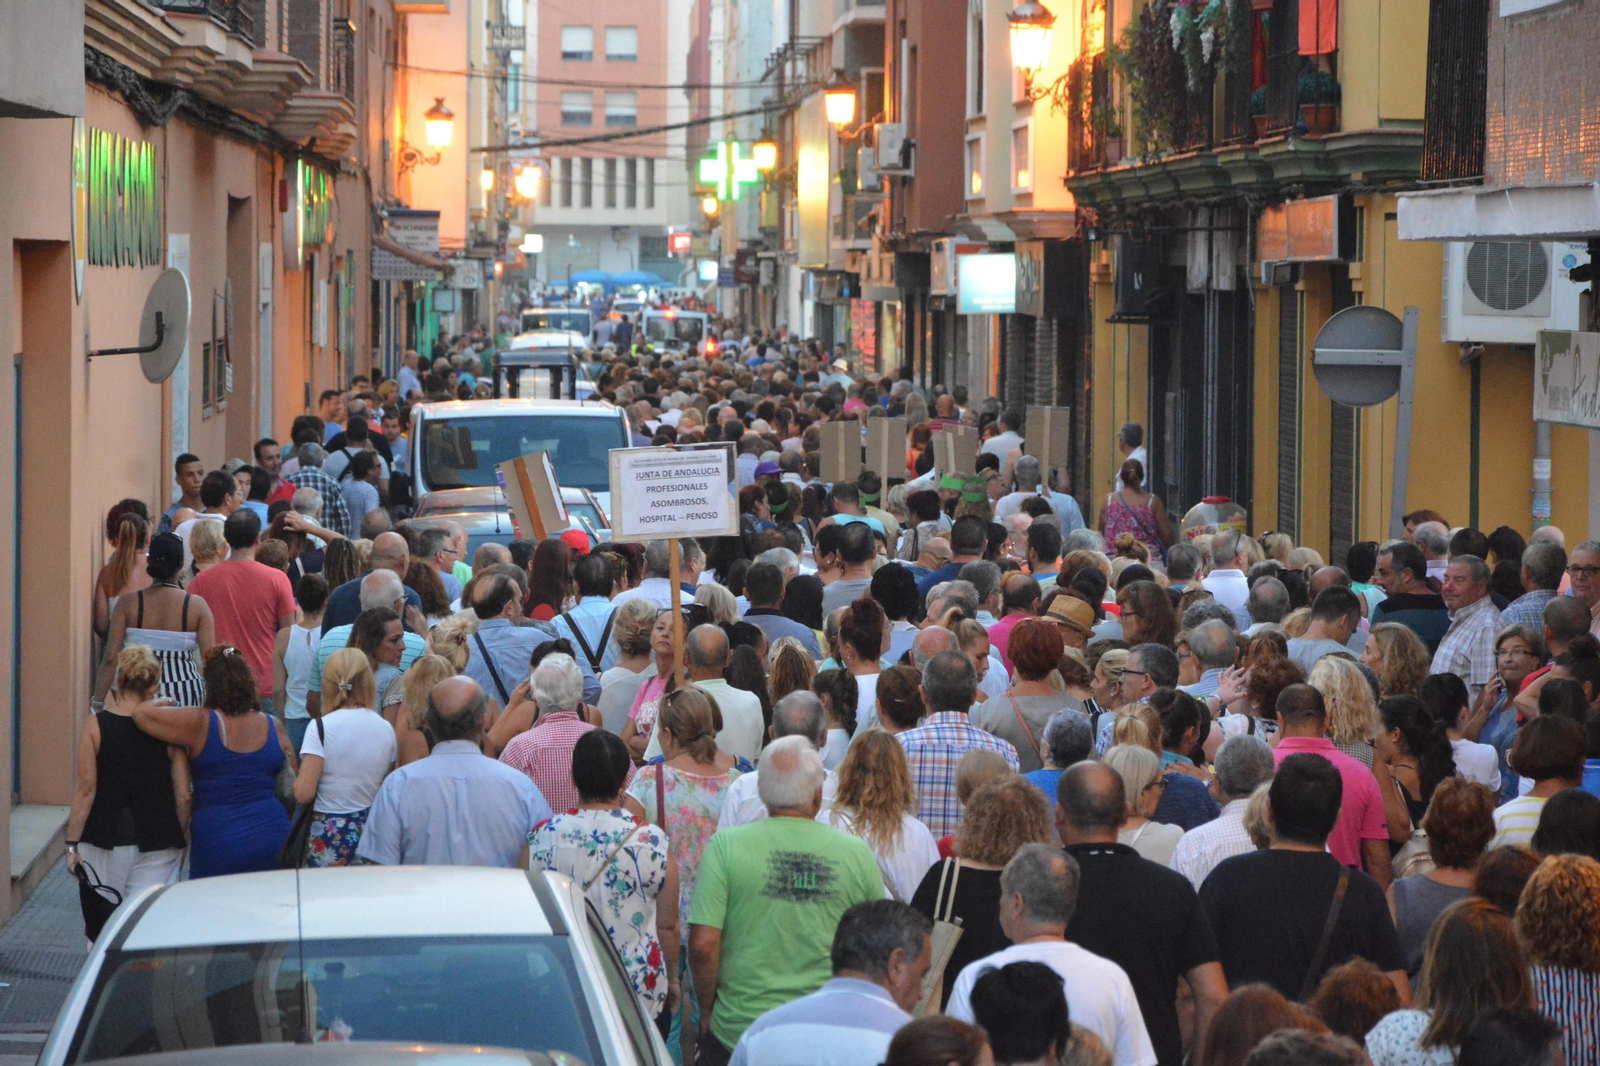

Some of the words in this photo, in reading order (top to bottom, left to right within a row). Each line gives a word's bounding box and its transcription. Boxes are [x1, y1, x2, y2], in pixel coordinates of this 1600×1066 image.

[635, 470, 661, 480] JUNTA
[662, 469, 673, 478] DE
[674, 467, 720, 477] ANDALUCIA
[646, 483, 708, 493] PROFESIONALES
[650, 498, 708, 508] ASOMBROSOS,
[639, 515, 676, 523] HOSPITAL
[686, 512, 718, 521] PENOSO
